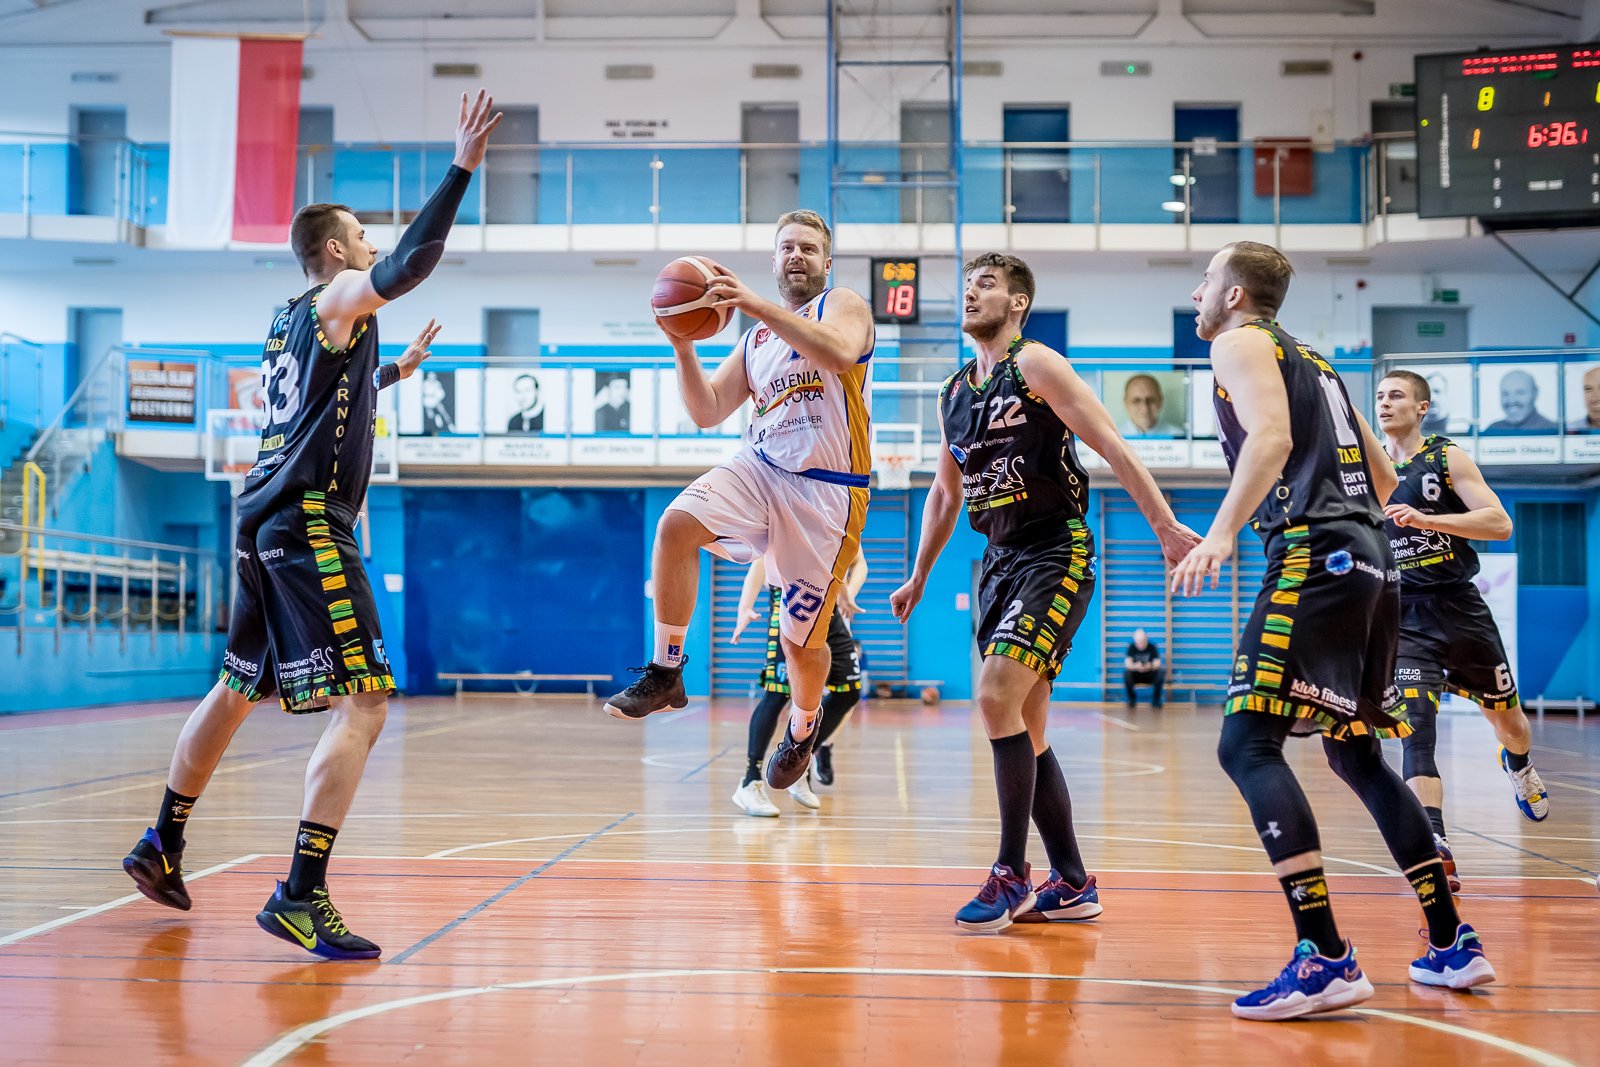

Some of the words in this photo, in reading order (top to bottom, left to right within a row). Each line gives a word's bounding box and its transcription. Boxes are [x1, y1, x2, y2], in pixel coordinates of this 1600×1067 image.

[1477, 86, 1495, 112] 8
[1471, 128, 1480, 150] 1
[886, 285, 915, 316] 18
[770, 370, 822, 397] JELENIA
[988, 395, 1028, 430] 22
[328, 373, 350, 492] ARNOVIA
[1337, 448, 1362, 464] TAR
[1421, 473, 1441, 501] 6
[782, 582, 823, 623] 12
[1494, 662, 1512, 692] 6
[1291, 679, 1320, 698] klub
[1321, 688, 1358, 712] fitness
